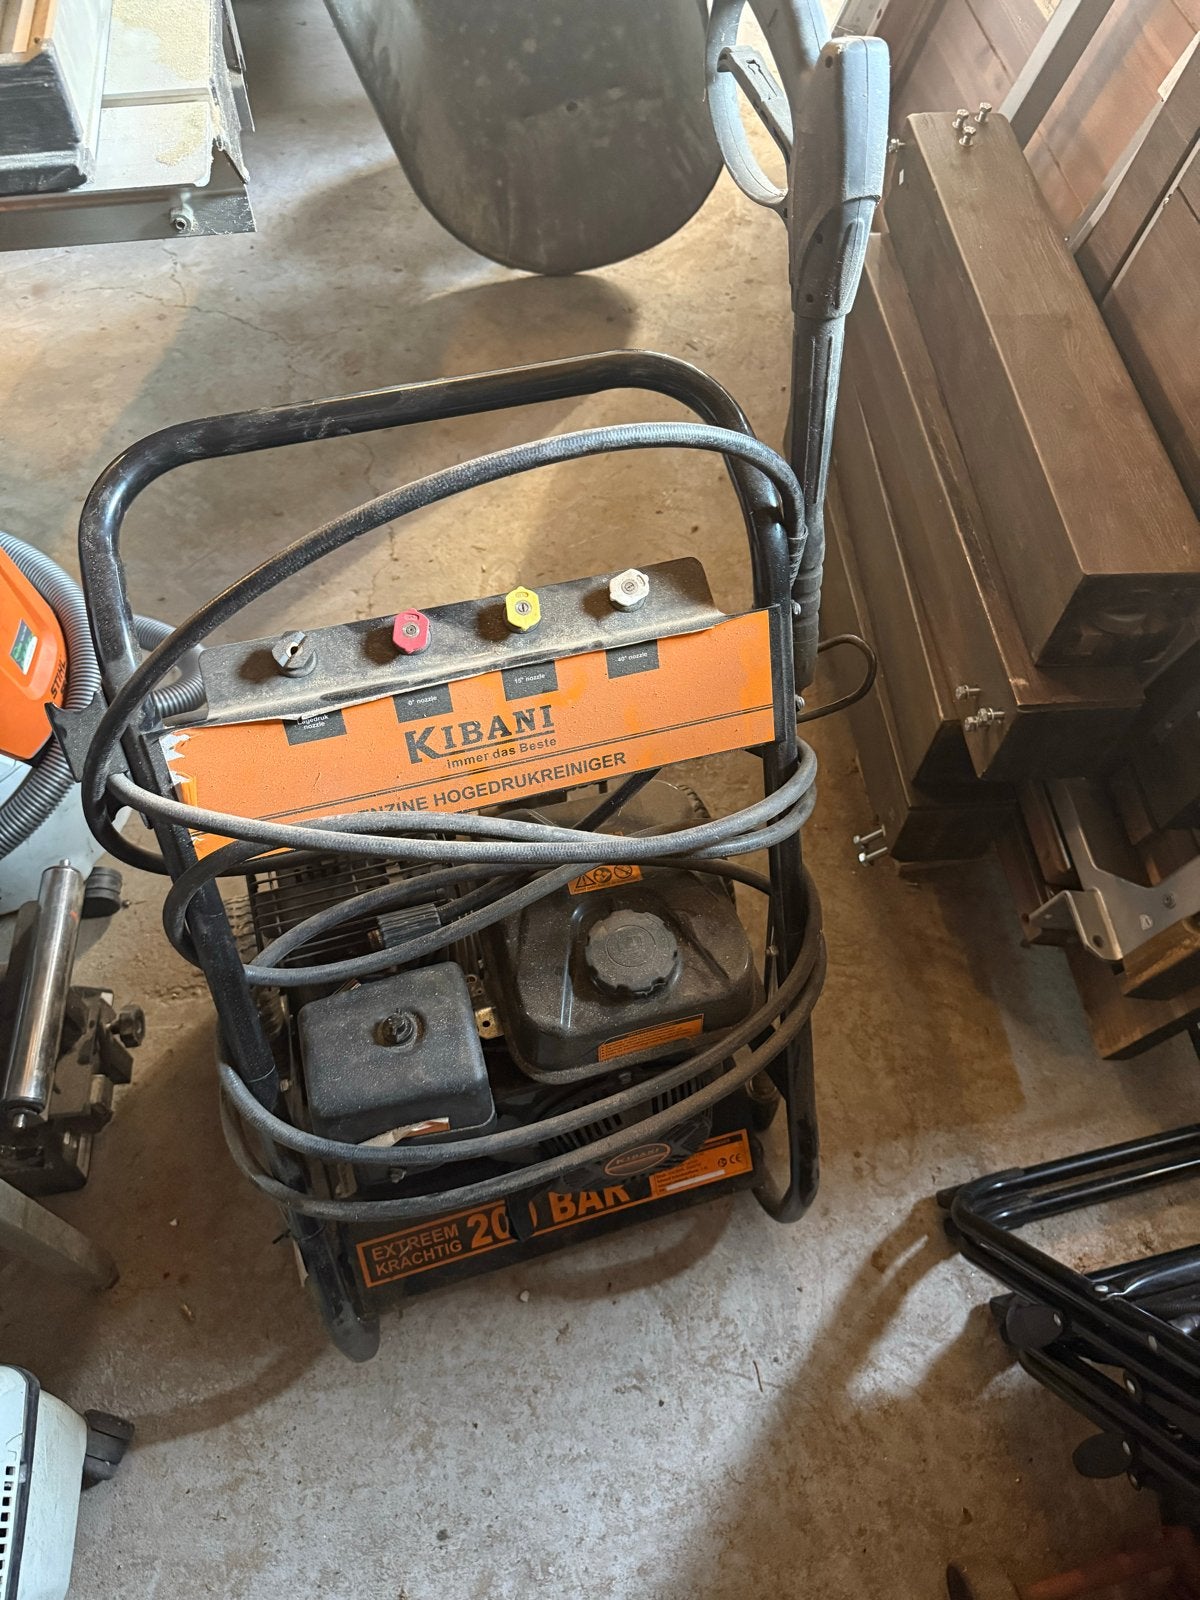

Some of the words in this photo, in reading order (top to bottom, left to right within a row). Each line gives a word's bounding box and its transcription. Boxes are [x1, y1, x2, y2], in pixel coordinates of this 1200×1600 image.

[628, 651, 648, 660] nozzle
[525, 673, 546, 682] nozzle
[416, 695, 438, 703] nozzle
[303, 721, 326, 730] nozzle
[405, 705, 555, 765] KIBANI
[447, 752, 489, 769] immer
[493, 746, 516, 760] das
[519, 738, 557, 754] Beste
[434, 752, 627, 807] HOGEDRUKREINIGER
[466, 1200, 538, 1249] 20
[371, 1224, 460, 1262] EXTREEM
[375, 1239, 463, 1277] KRACHTIG
